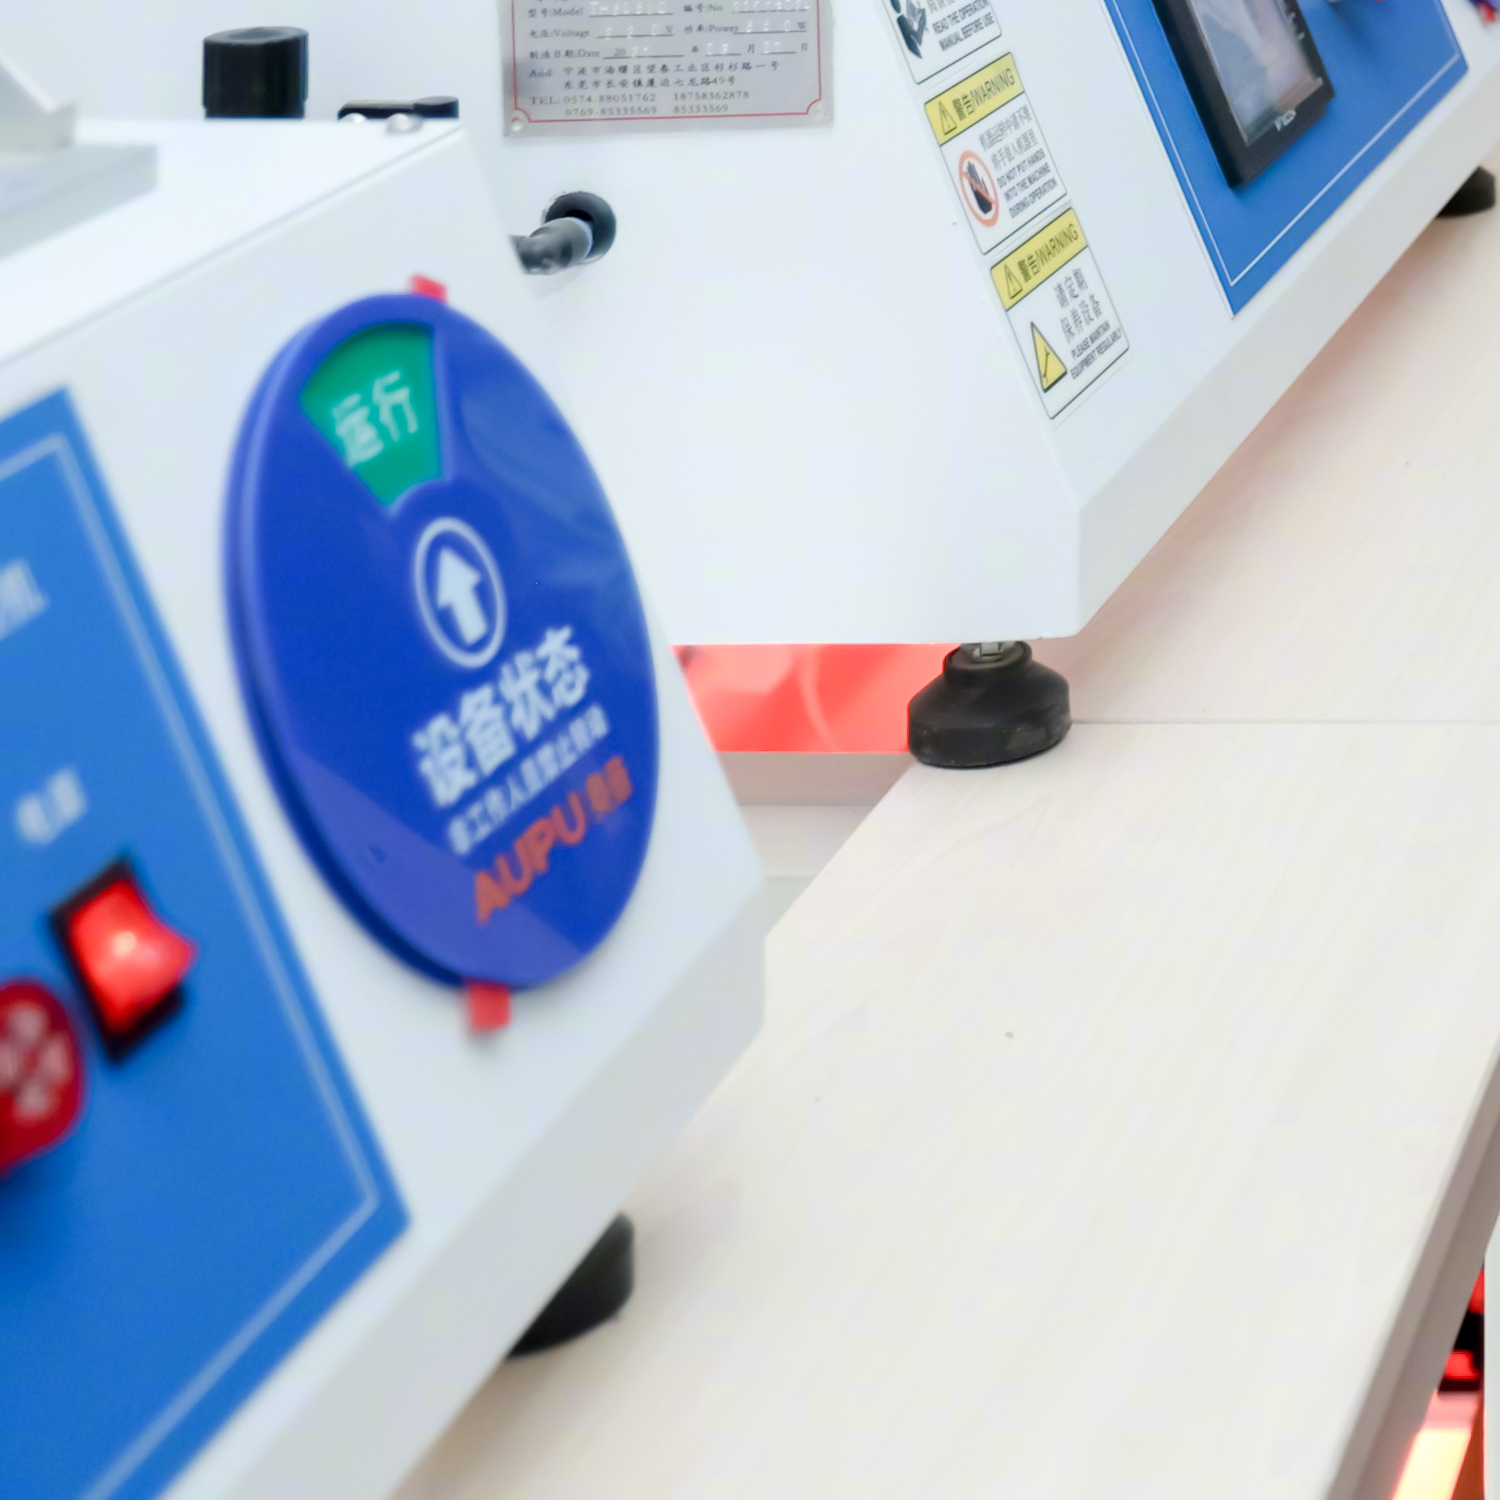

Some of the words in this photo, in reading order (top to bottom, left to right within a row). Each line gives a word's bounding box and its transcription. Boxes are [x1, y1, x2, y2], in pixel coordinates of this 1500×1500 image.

[932, 18, 949, 35] READ
[947, 12, 960, 26] THE
[939, 30, 963, 52] MANUAL
[961, 19, 983, 39] BEFORE
[982, 13, 994, 26] USE
[952, 67, 1016, 120] 警告/WARNING
[997, 176, 1006, 188] DO
[1005, 168, 1018, 182] NOT
[1016, 161, 1027, 174] PUT
[1026, 148, 1045, 167] HANDS
[1004, 187, 1018, 202] INTO
[1016, 179, 1028, 193] THE
[1027, 163, 1050, 185] MACHINE
[1009, 197, 1030, 219] DURING
[1028, 177, 1057, 204] OPERATION
[1017, 221, 1079, 282] 警告/WARNING
[1071, 338, 1090, 360] PLEASE
[1088, 319, 1110, 344] MAINTAIN
[1070, 350, 1097, 380] EQUIPMENT
[331, 371, 419, 468] 运行
[411, 624, 591, 808] 设备状态
[474, 791, 587, 927] AUPU
